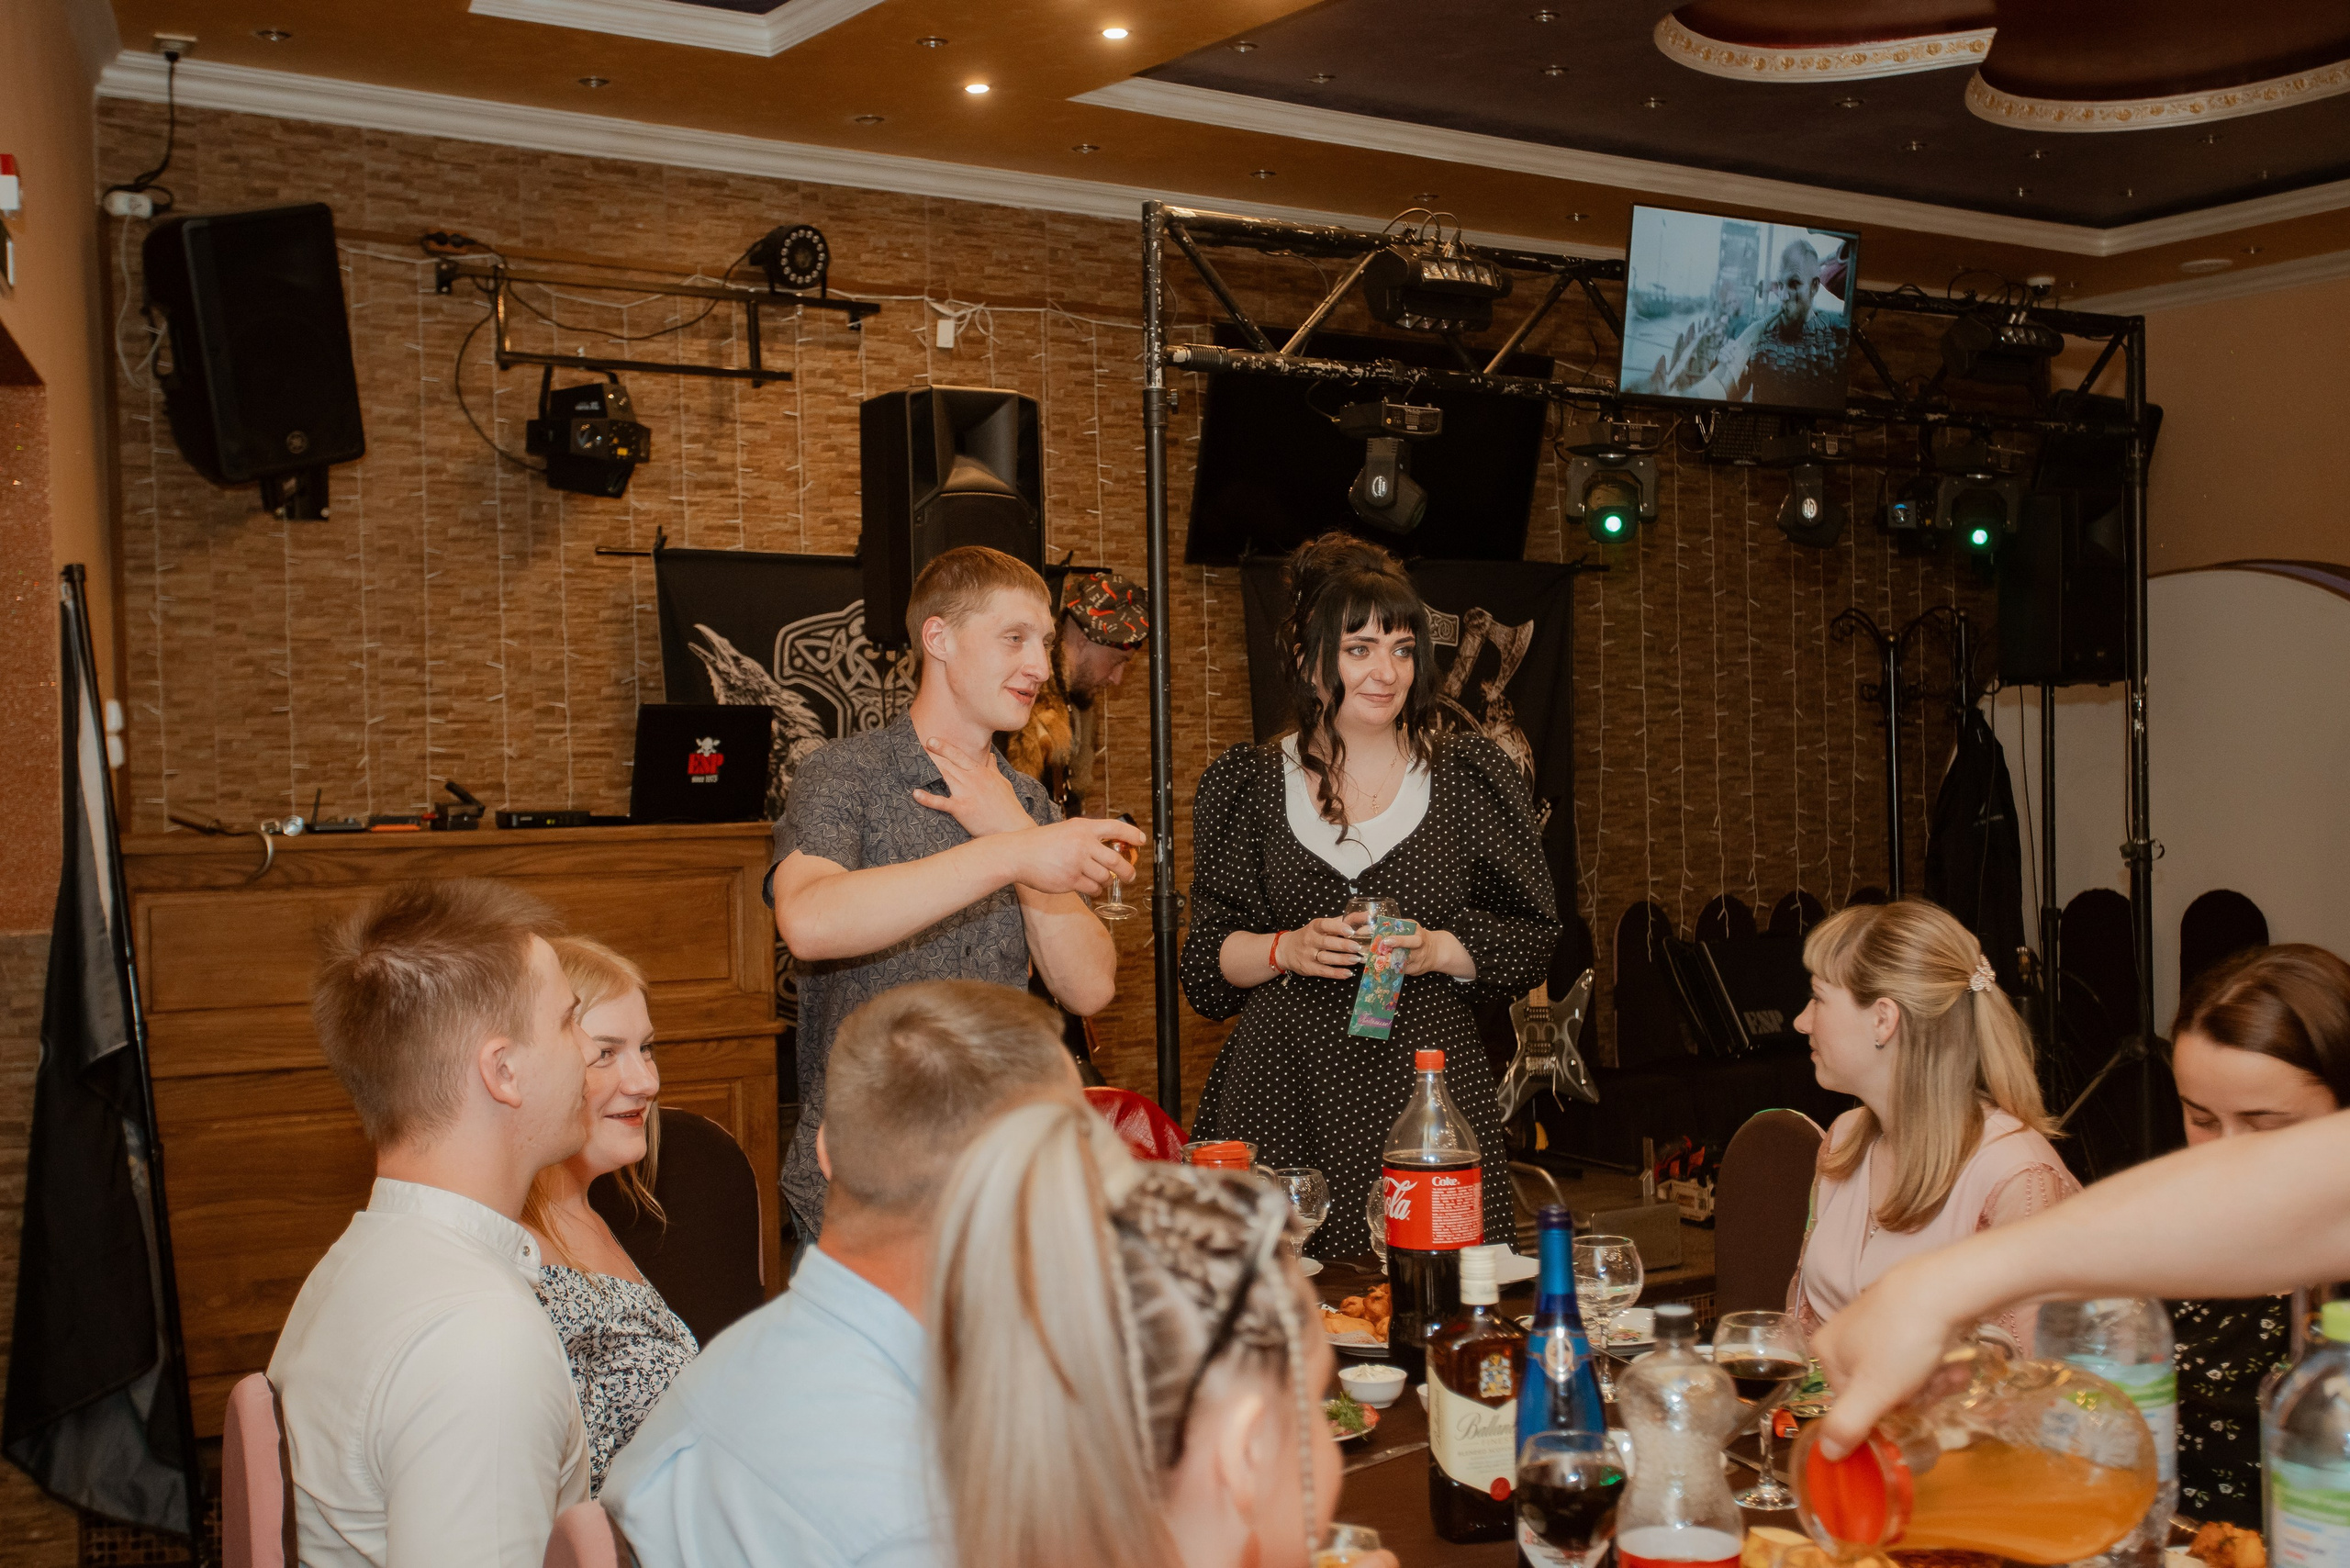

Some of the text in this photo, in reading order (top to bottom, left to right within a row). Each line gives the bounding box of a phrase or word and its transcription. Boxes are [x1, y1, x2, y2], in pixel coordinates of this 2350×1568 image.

[688, 753, 724, 775] ESP
[1743, 1010, 1784, 1035] ESP
[1432, 1176, 1458, 1187] Coke
[1455, 1413, 1516, 1441] Ballan
